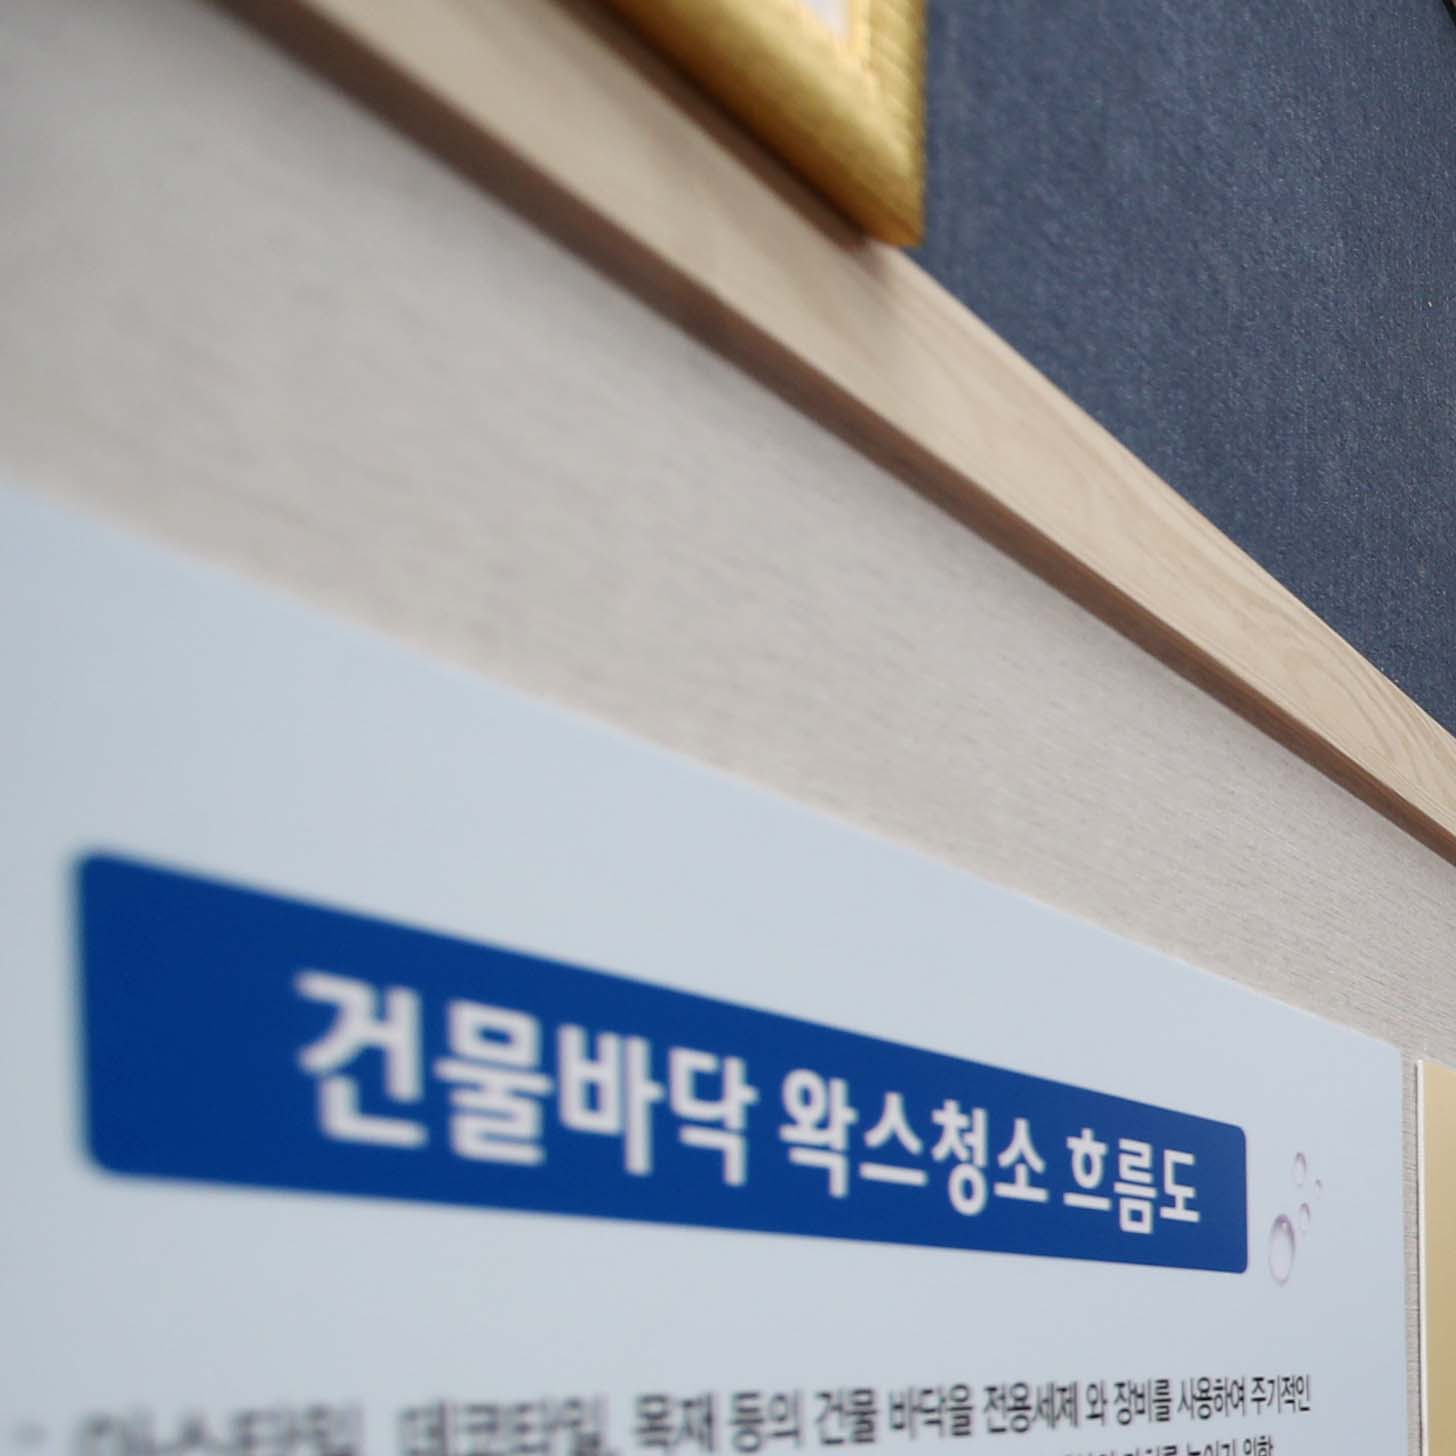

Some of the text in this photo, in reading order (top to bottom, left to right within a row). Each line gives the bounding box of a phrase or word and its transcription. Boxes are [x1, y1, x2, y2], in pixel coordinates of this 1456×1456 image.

[293, 968, 1201, 1235] 건물바닥 왁스청소 흐름도
[632, 1392, 719, 1456] 목재
[729, 1391, 802, 1454] 등의
[814, 1386, 878, 1447] 건물
[887, 1383, 974, 1439] 바닥을
[982, 1380, 1080, 1436] 전용세제
[1084, 1382, 1107, 1422] 와
[1113, 1378, 1173, 1427] 장비를
[1177, 1376, 1246, 1423] 사용하여
[1250, 1374, 1311, 1417] 주기적인
